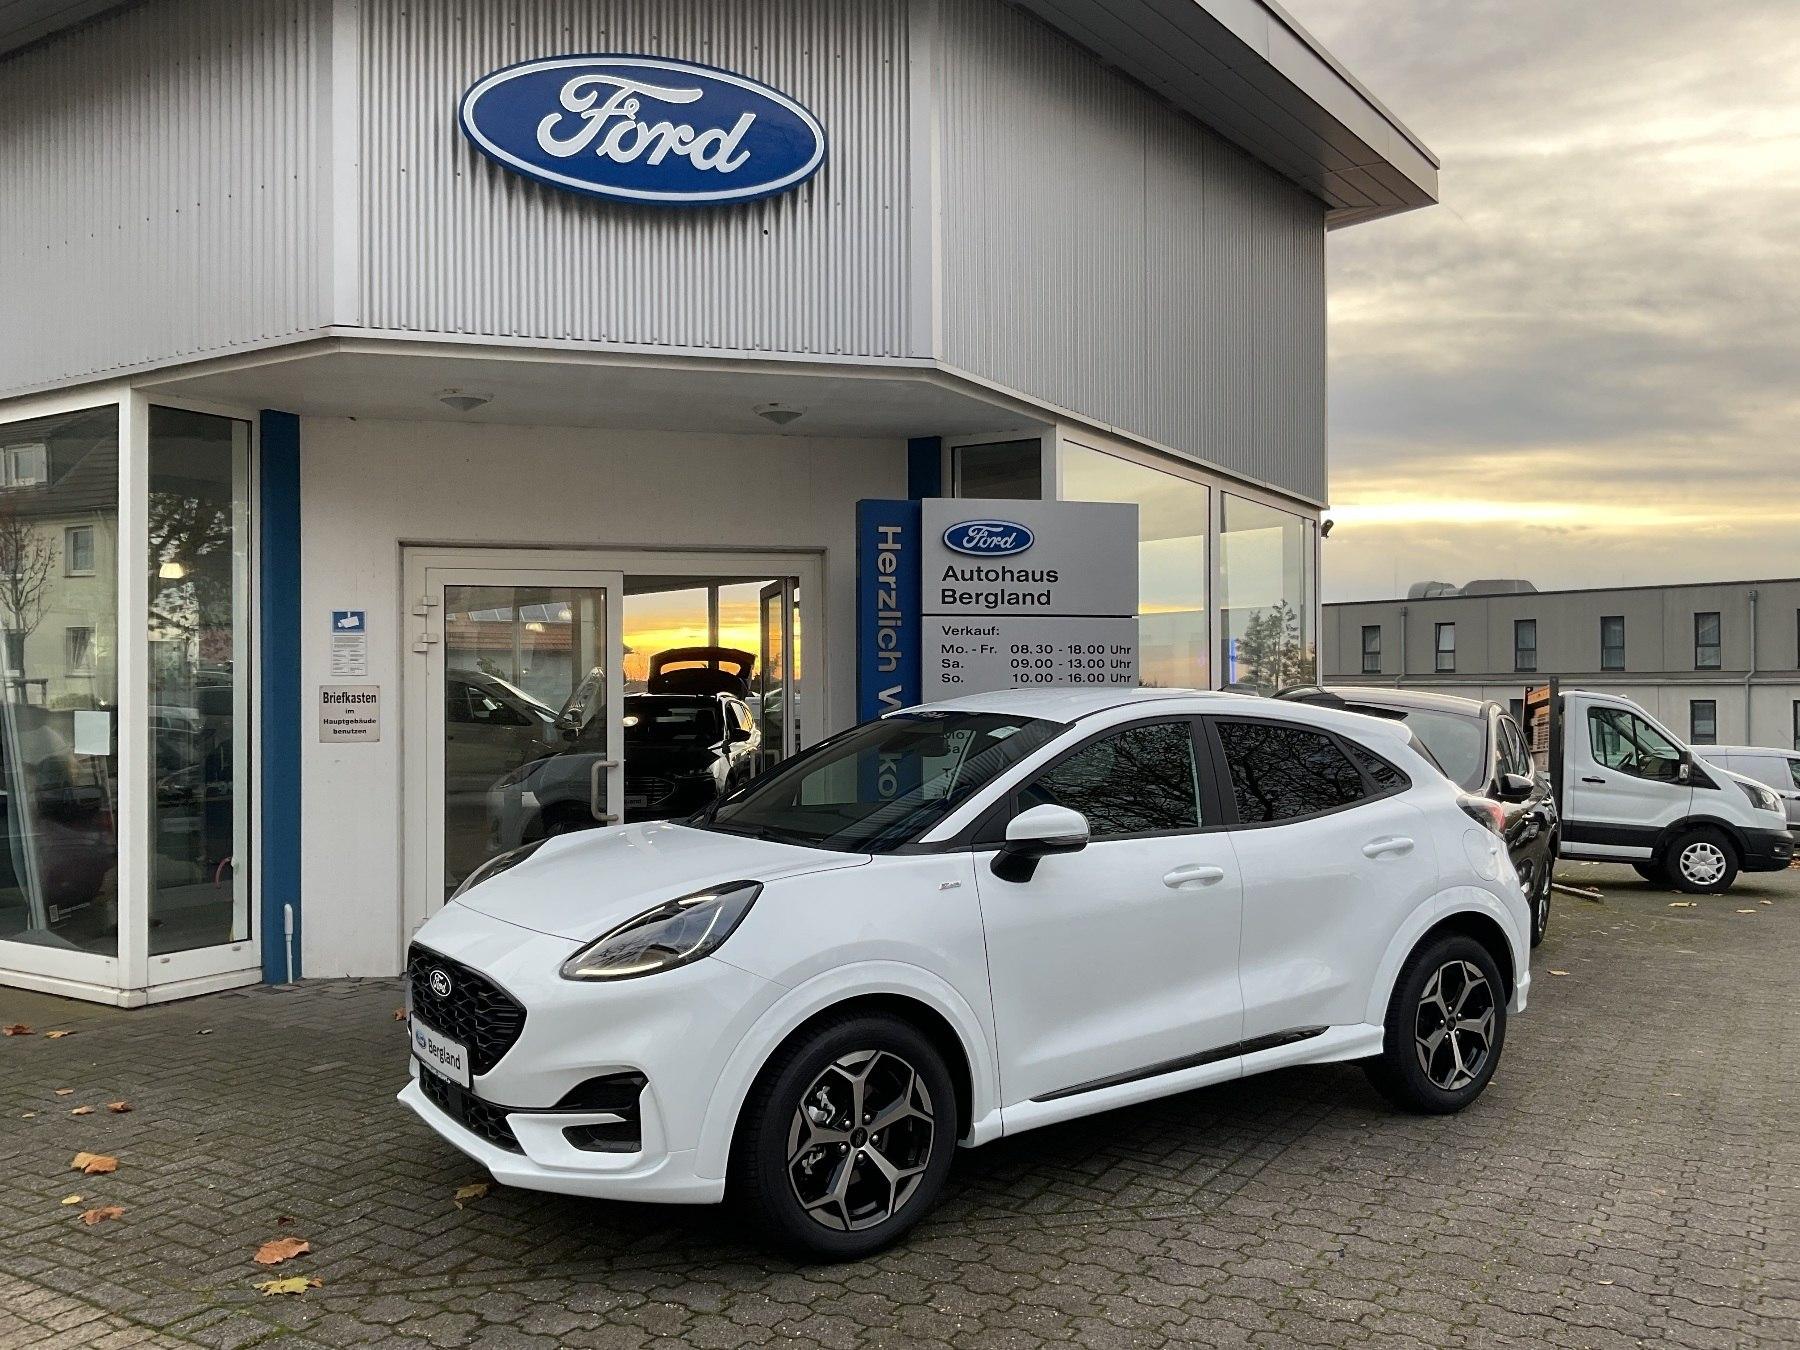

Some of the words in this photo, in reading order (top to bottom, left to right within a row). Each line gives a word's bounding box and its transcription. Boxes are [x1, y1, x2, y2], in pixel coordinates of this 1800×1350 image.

[537, 74, 757, 173] Ford
[962, 525, 1017, 549] Ford
[941, 565, 1059, 583] Autohaus
[877, 526, 902, 672] Herzlich
[941, 588, 1051, 610] Bergland
[941, 625, 1000, 636] Verkauf:
[941, 644, 968, 654] Mo.
[980, 644, 997, 654] Fr.
[1010, 644, 1053, 654] 08.30
[1067, 644, 1105, 654] 18.00
[1110, 645, 1132, 655] Uhr
[941, 658, 964, 668] Sa.
[1010, 658, 1053, 668] 09.00
[1067, 659, 1105, 669] 13.00
[1110, 659, 1132, 669] Uhr
[941, 673, 964, 683] So.
[1012, 673, 1053, 683] 10.00
[1067, 673, 1105, 683] 16.00
[1110, 673, 1132, 683] Uhr
[323, 691, 377, 703] Briefkasten
[428, 1038, 461, 1070] Bergland
